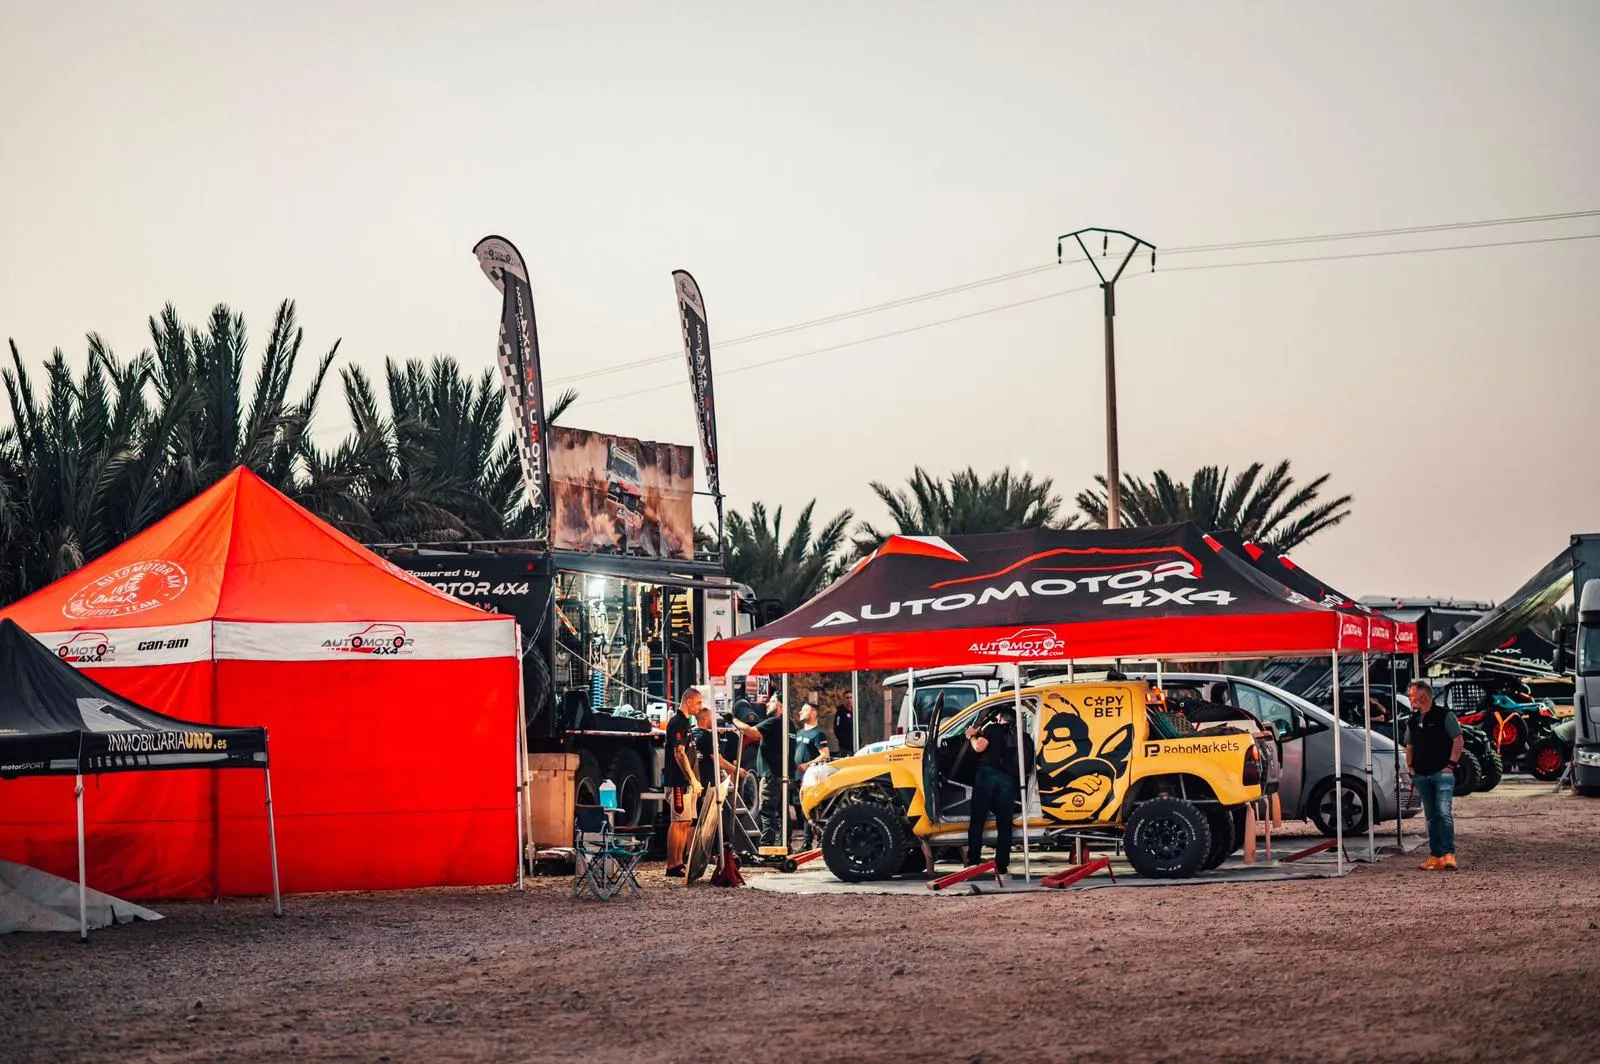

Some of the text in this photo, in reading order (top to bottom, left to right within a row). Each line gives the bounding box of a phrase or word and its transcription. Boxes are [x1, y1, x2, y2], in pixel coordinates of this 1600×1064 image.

[464, 569, 480, 578] by
[492, 582, 530, 595] 4X4
[811, 560, 1197, 629] AUTOMOTOR
[1102, 587, 1238, 607] 4X4
[137, 638, 189, 651] can-am
[321, 635, 415, 649] AUTOMOTOR
[967, 638, 1066, 652] AUTOMOTOR
[1093, 706, 1124, 718] BET
[1163, 740, 1240, 755] RoboMarkets
